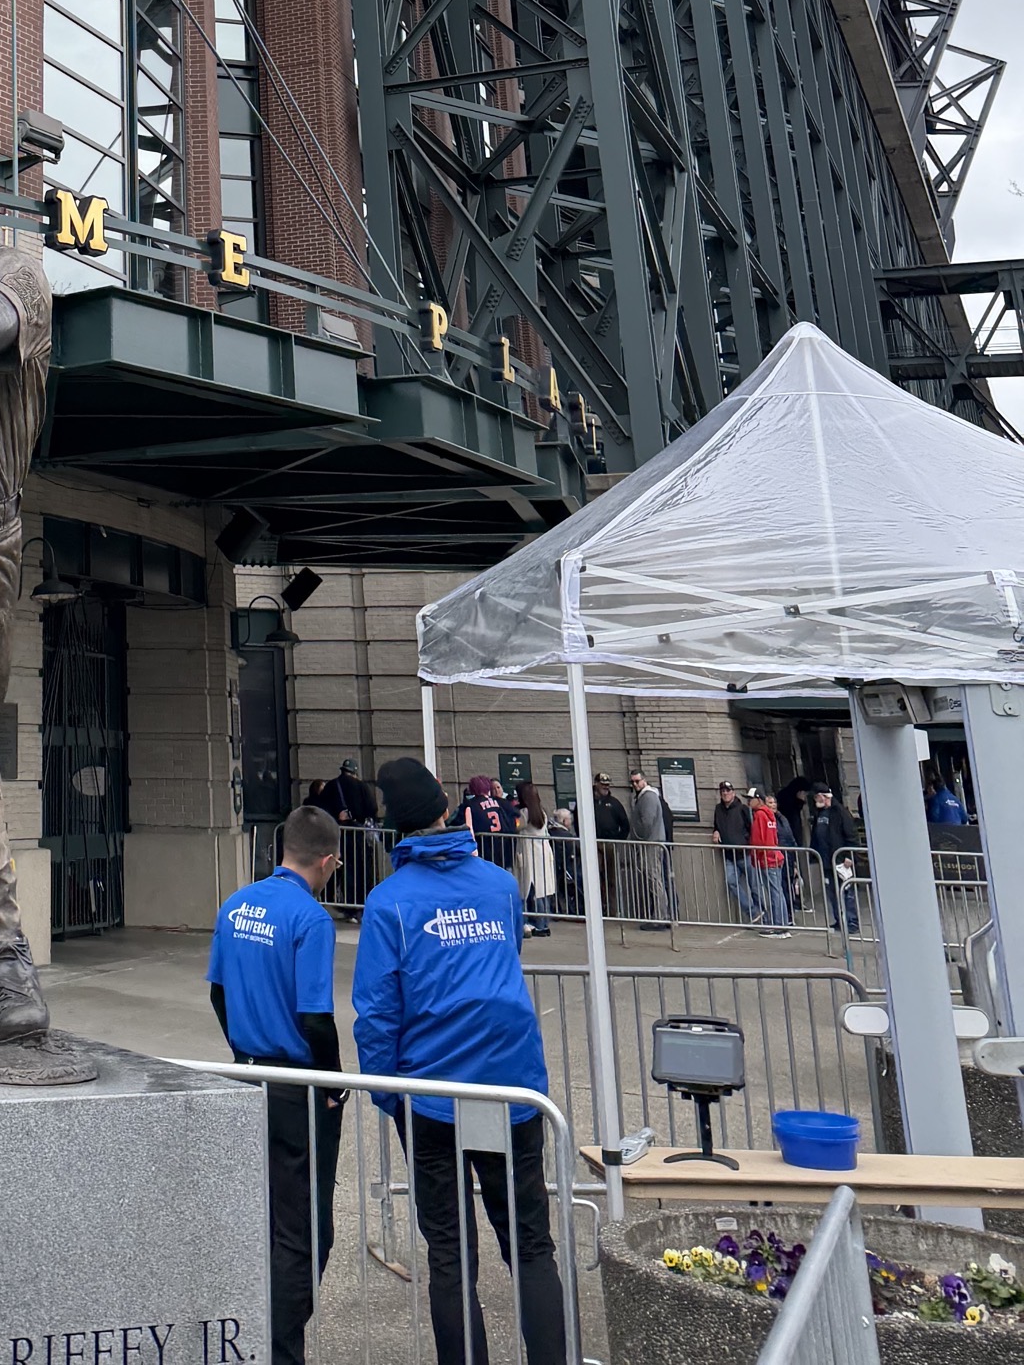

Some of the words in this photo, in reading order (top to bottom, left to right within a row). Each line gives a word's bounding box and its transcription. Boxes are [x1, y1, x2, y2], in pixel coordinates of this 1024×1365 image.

[487, 811, 502, 832] 3
[237, 901, 267, 919] ALLIED
[436, 908, 478, 924] ALLIED
[234, 915, 275, 938] UNIVERSAL
[438, 920, 505, 940] UNIVERSAL
[440, 938, 466, 947] EVENT
[469, 934, 507, 944] SERVICES
[197, 1318, 256, 1365] JR.
